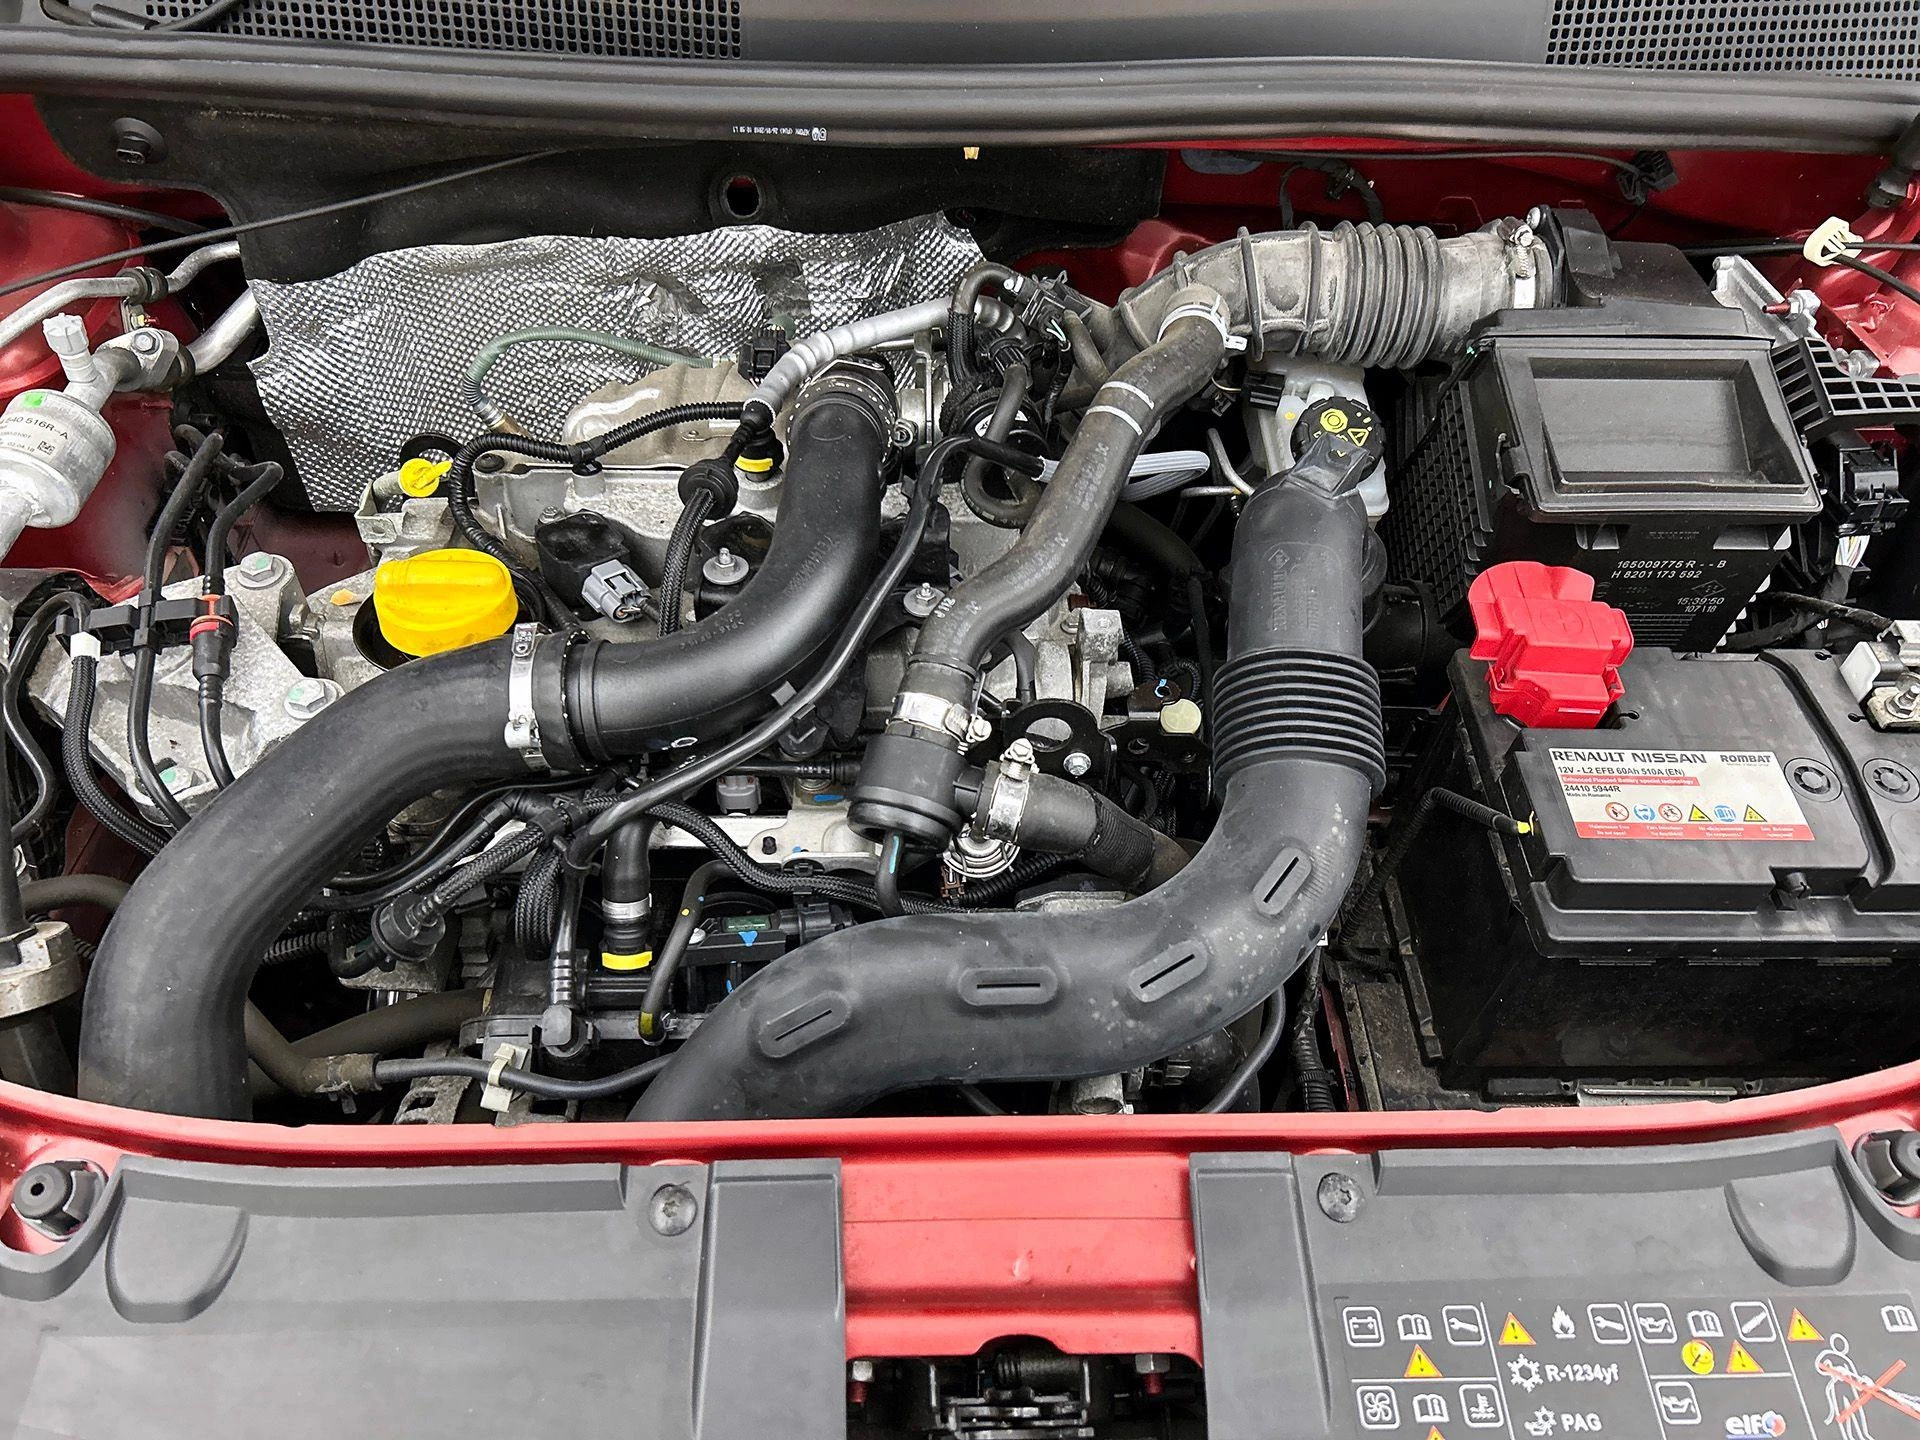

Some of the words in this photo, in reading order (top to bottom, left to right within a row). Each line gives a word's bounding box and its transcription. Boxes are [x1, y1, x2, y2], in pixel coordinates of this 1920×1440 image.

[1716, 559, 1727, 568] B
[1610, 570, 1622, 579] H
[1623, 570, 1654, 579] 8201
[1656, 570, 1676, 579] 173
[1678, 570, 1702, 579] 592
[1677, 597, 1725, 606] 15:39:50
[1552, 751, 1625, 762] RENAULT
[1632, 752, 1707, 763] NISSAN
[1557, 766, 1575, 774] 12V
[1582, 766, 1594, 775] L2
[1595, 766, 1615, 775] EFB
[1616, 766, 1640, 776] 60Ah
[1641, 767, 1664, 776] 510A
[1664, 768, 1686, 777] (EN)
[1563, 784, 1591, 792] 24410
[1592, 785, 1622, 793] 5944R
[1544, 1363, 1619, 1385] R-1234yf
[1560, 1412, 1602, 1432] PAG
[1725, 1413, 1763, 1435] elf
